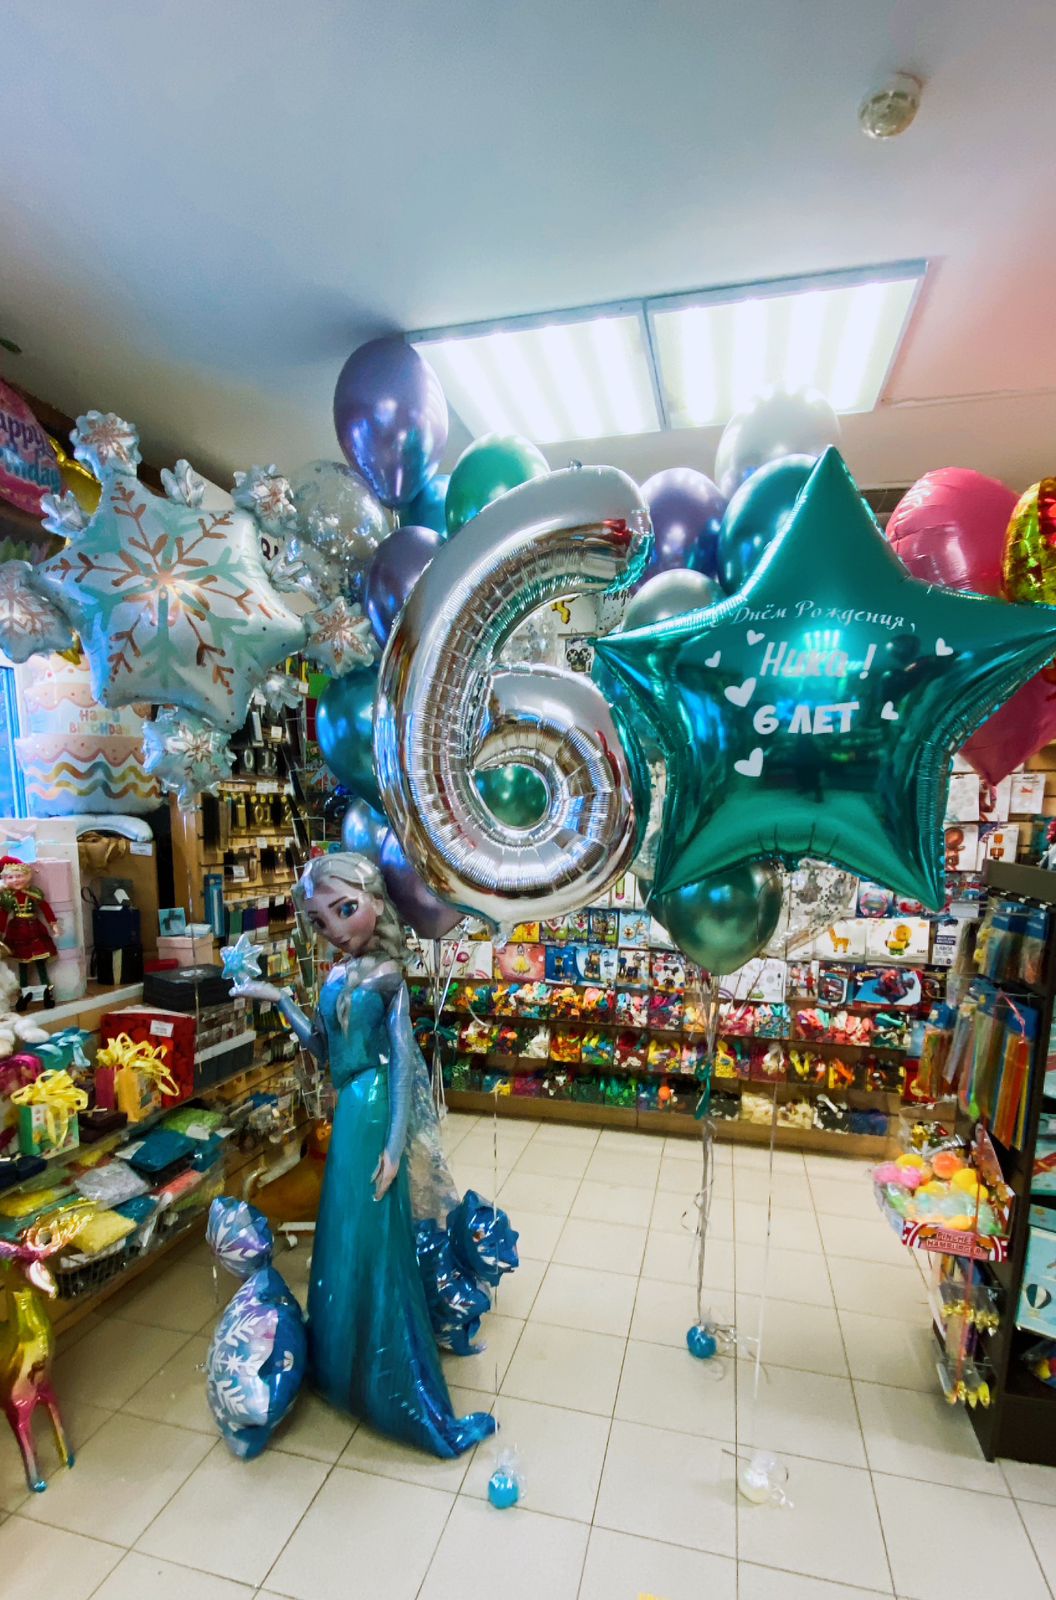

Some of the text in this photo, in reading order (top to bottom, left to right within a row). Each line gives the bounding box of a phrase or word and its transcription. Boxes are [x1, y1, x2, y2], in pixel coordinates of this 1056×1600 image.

[730, 604, 787, 625] Днём
[753, 702, 860, 735] 6 ЛЕТ
